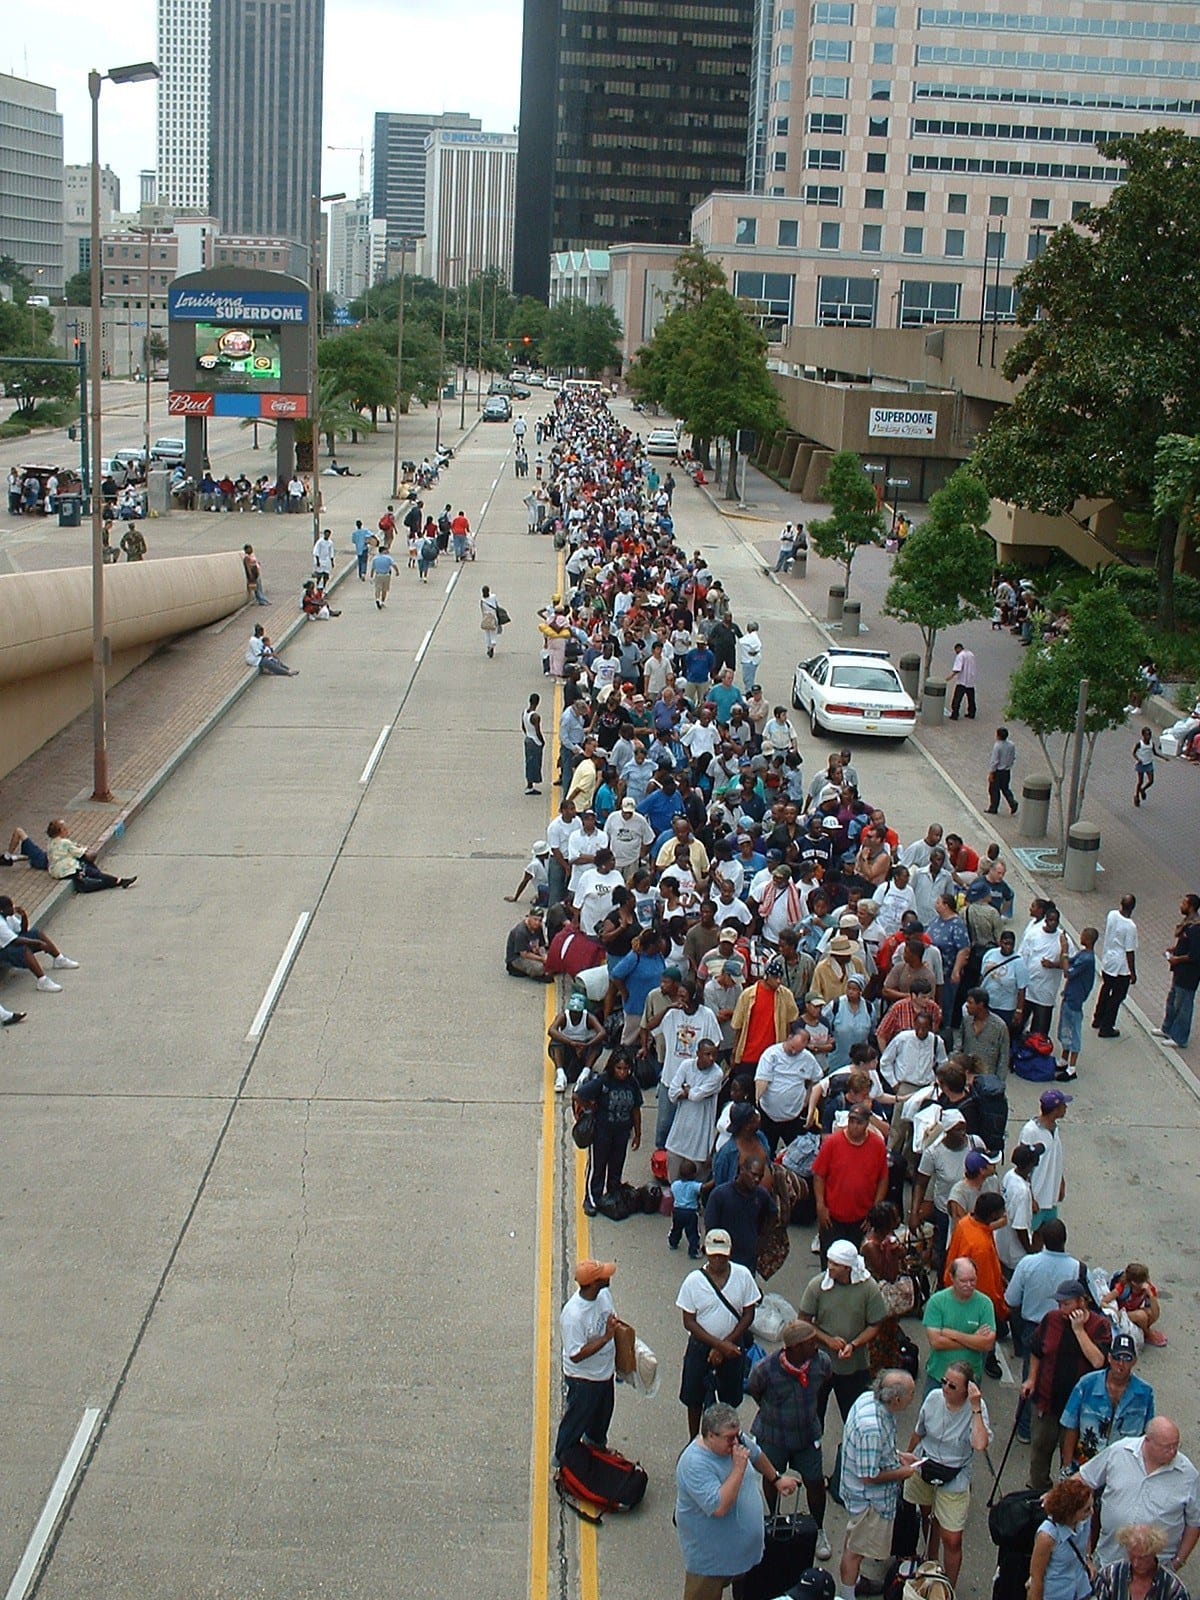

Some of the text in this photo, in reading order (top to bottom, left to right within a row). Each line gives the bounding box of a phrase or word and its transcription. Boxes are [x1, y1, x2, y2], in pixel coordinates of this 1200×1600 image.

[175, 291, 244, 309] Louisiana
[216, 306, 303, 320] SUPERDOME
[169, 394, 212, 412] Bud
[875, 411, 933, 424] SUPERDOME
